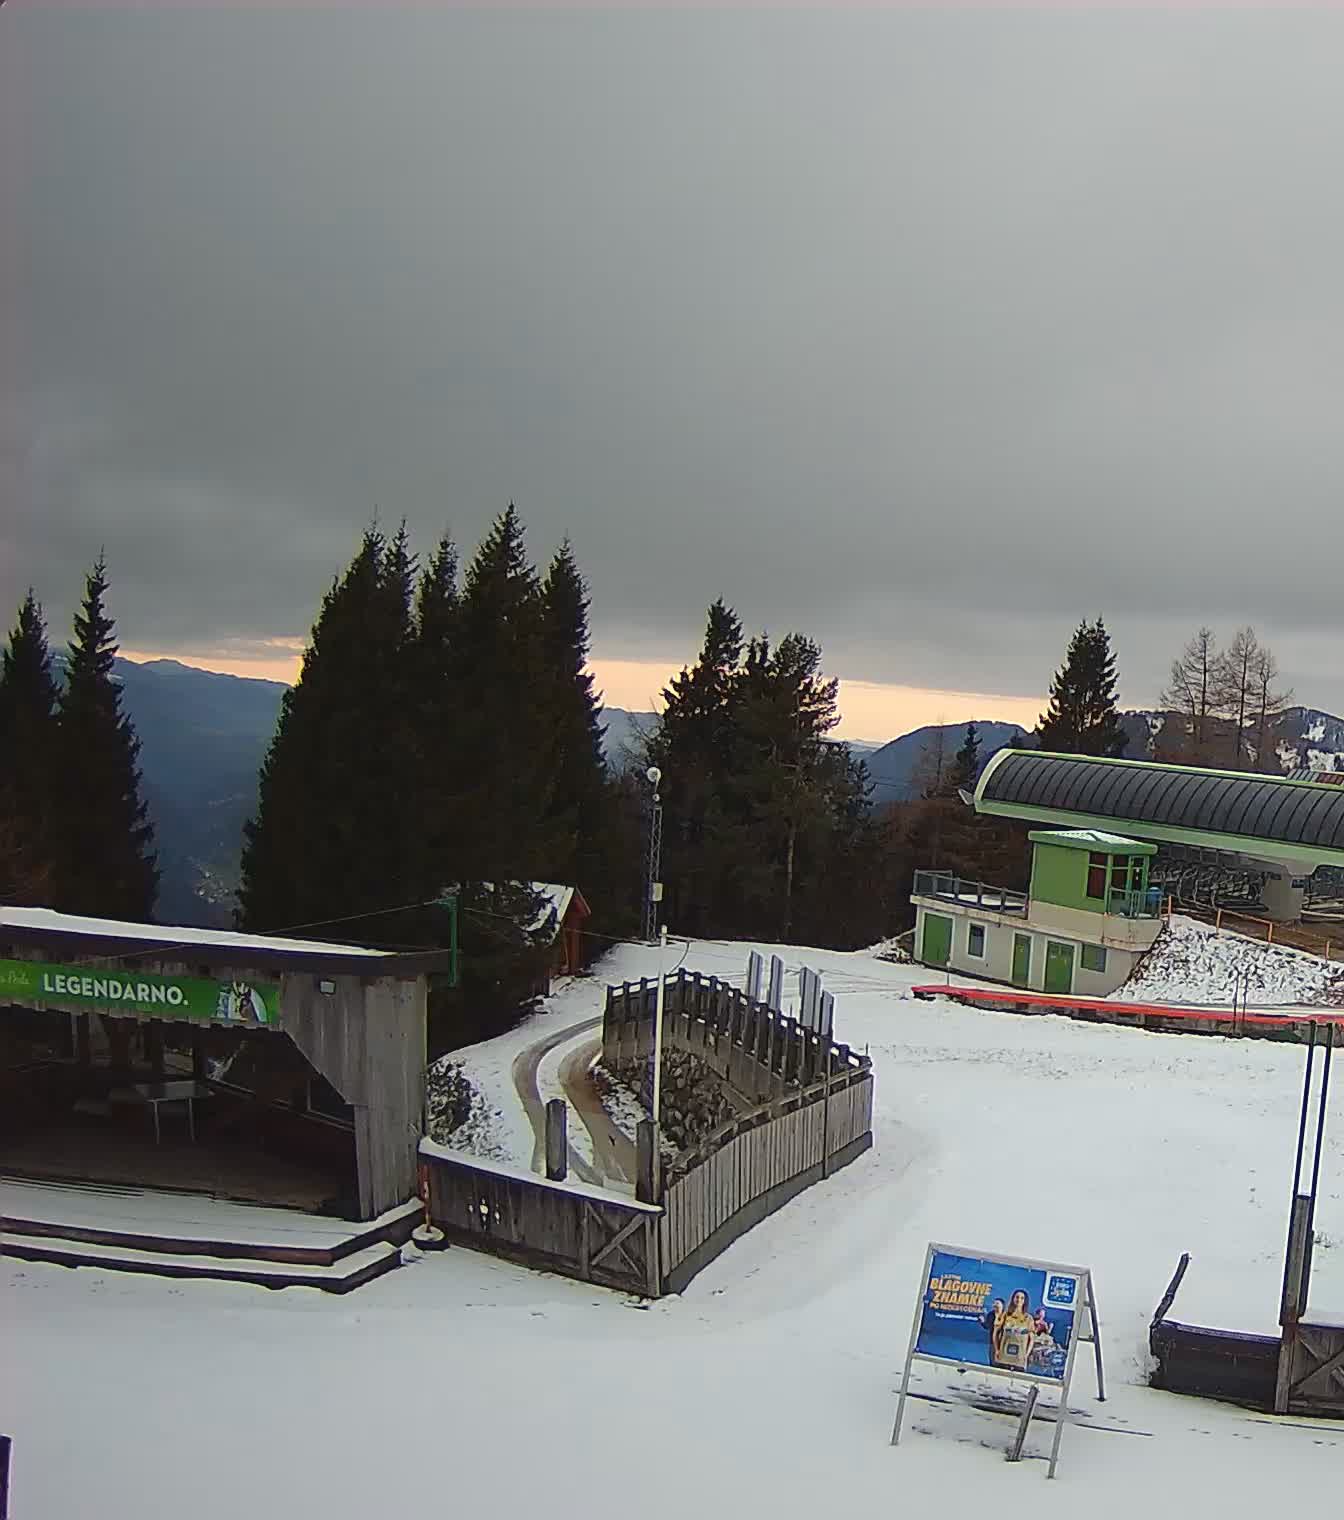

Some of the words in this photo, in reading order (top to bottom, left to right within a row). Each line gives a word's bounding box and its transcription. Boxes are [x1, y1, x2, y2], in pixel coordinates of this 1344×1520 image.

[43, 972, 190, 1006] LEGENDARNO.
[929, 1277, 993, 1296] BLAGOVNE
[932, 1290, 985, 1306] ZNAMKE
